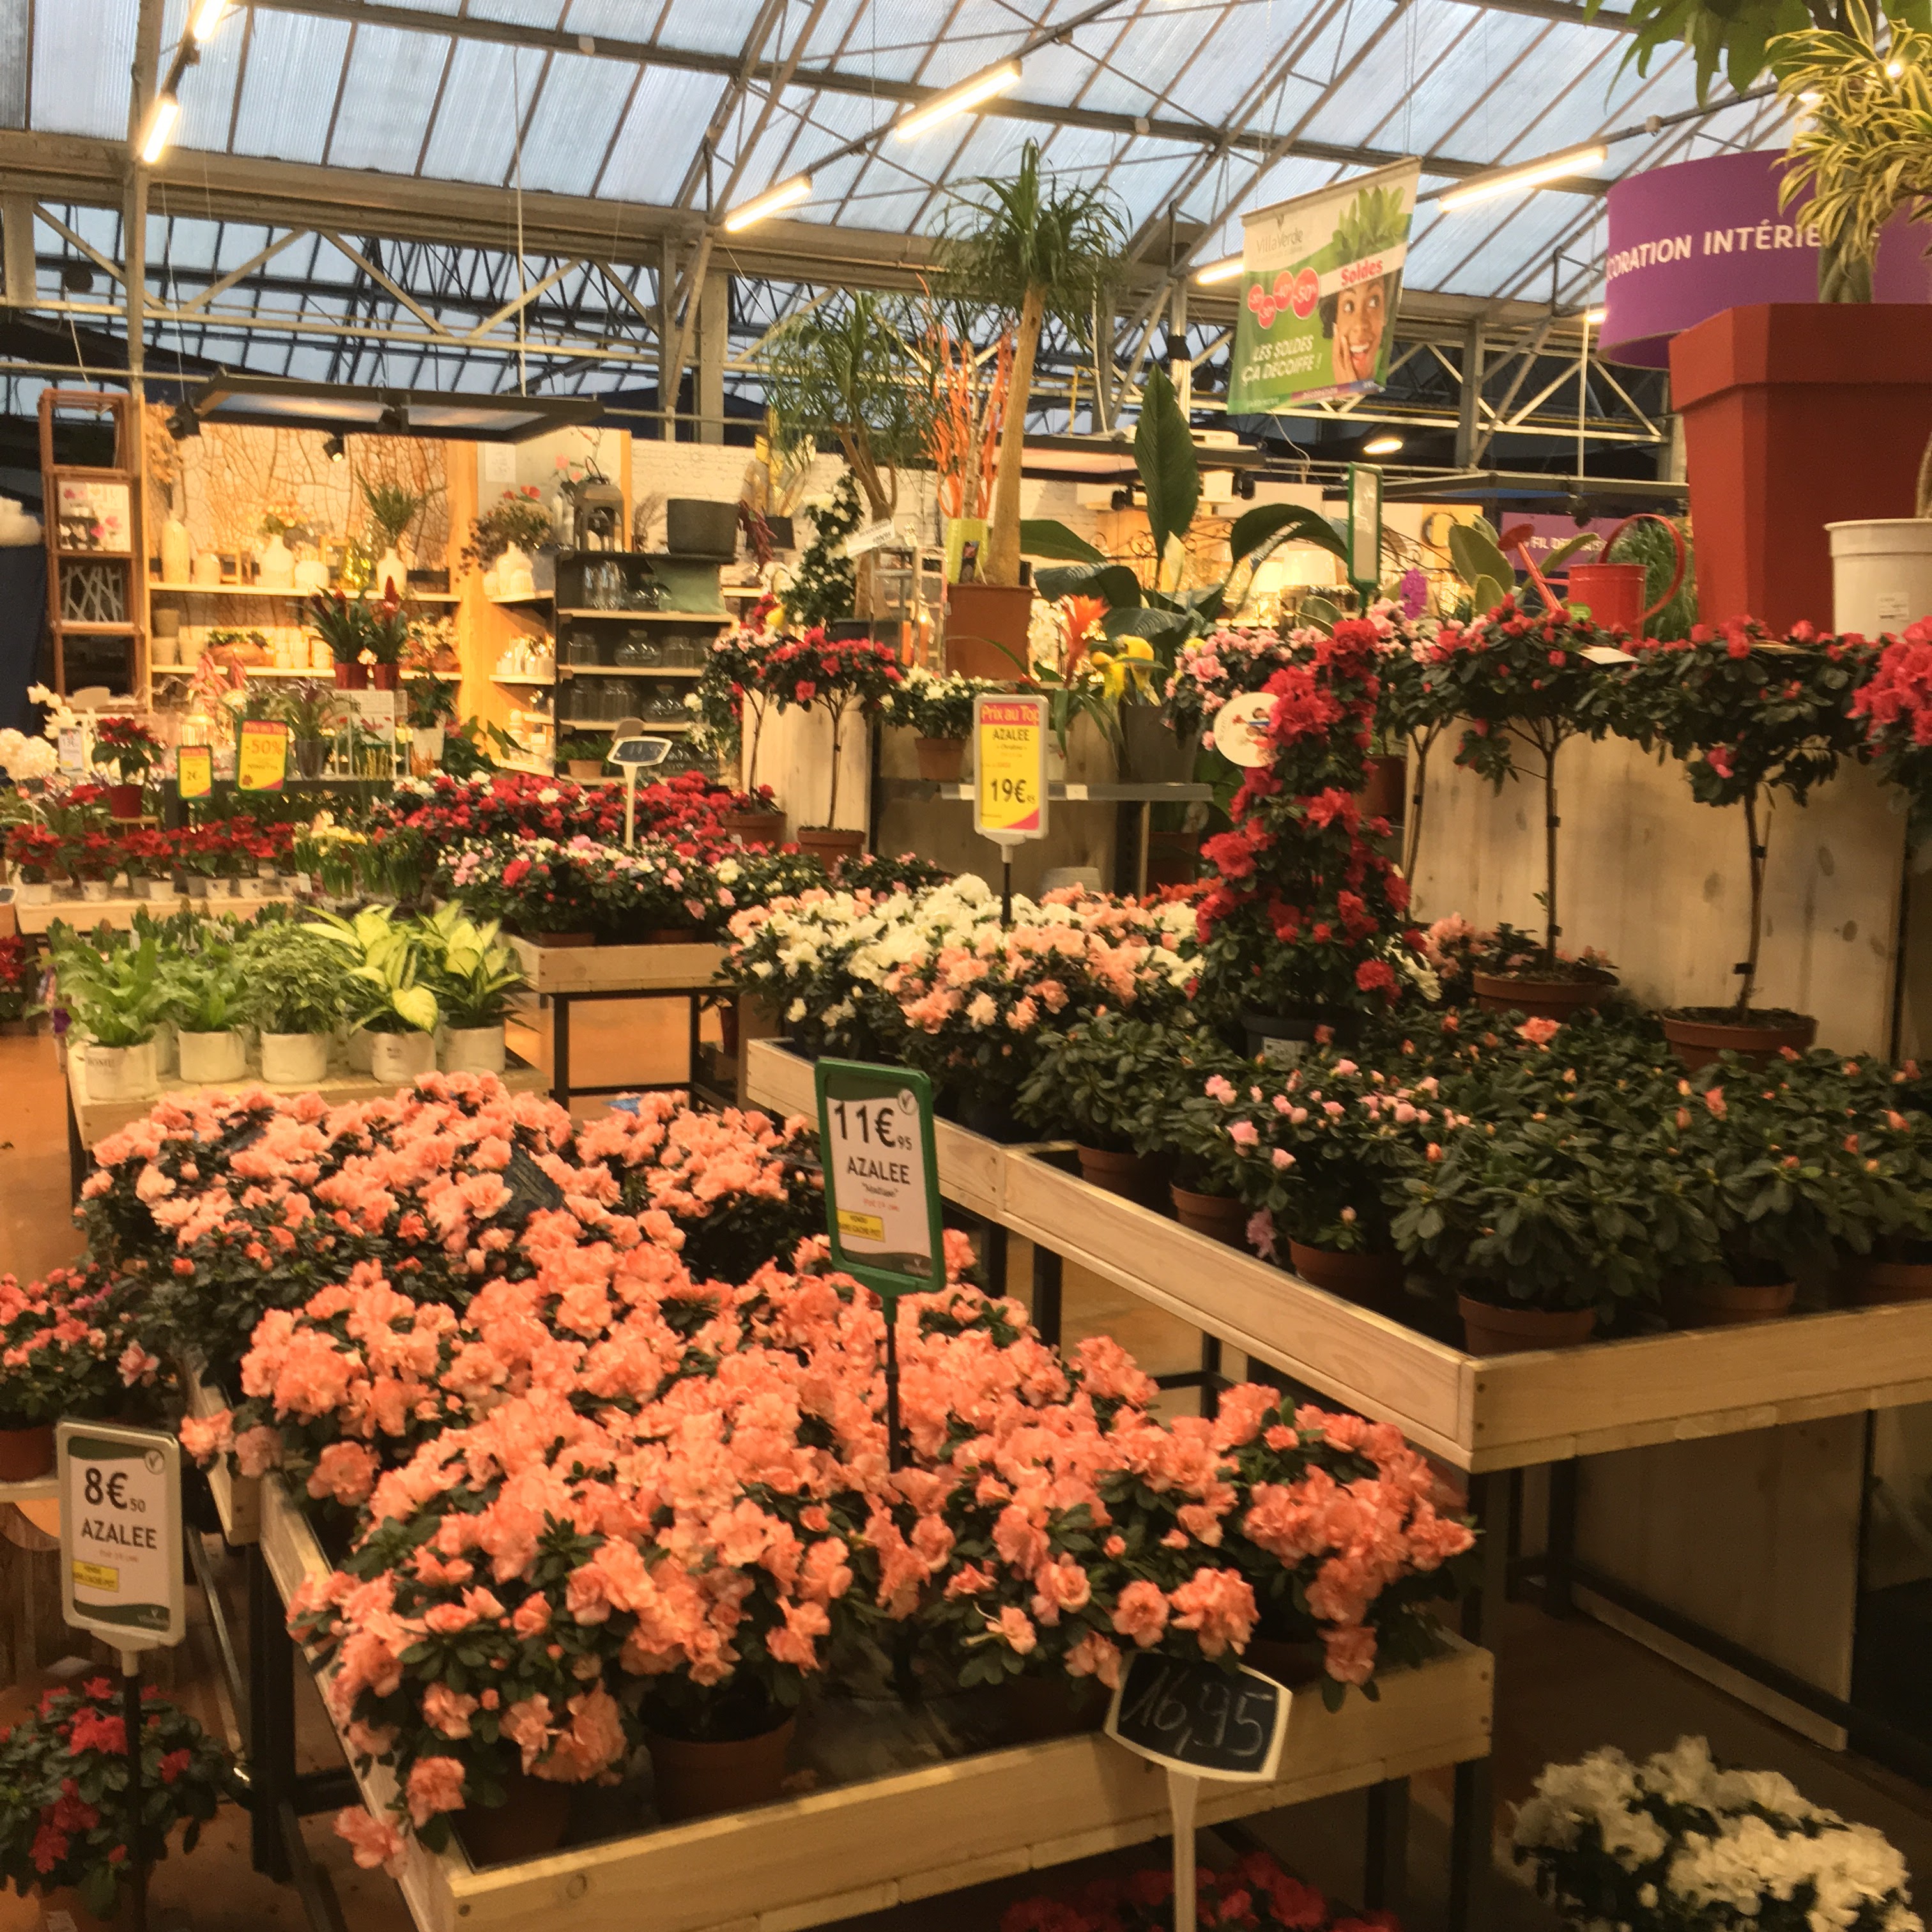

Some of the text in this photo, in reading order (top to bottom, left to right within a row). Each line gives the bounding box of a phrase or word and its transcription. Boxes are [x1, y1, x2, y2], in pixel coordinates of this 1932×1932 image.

[1256, 227, 1303, 254] VillaVerde
[1341, 259, 1383, 287] Soldes
[1252, 334, 1314, 362] LES SOLDES
[981, 705, 1039, 726] Prix au Top
[245, 738, 284, 756] -50%
[992, 727, 1030, 741] AZALEE
[847, 1154, 911, 1185] AZALEE
[80, 1516, 157, 1551] AZALEE
